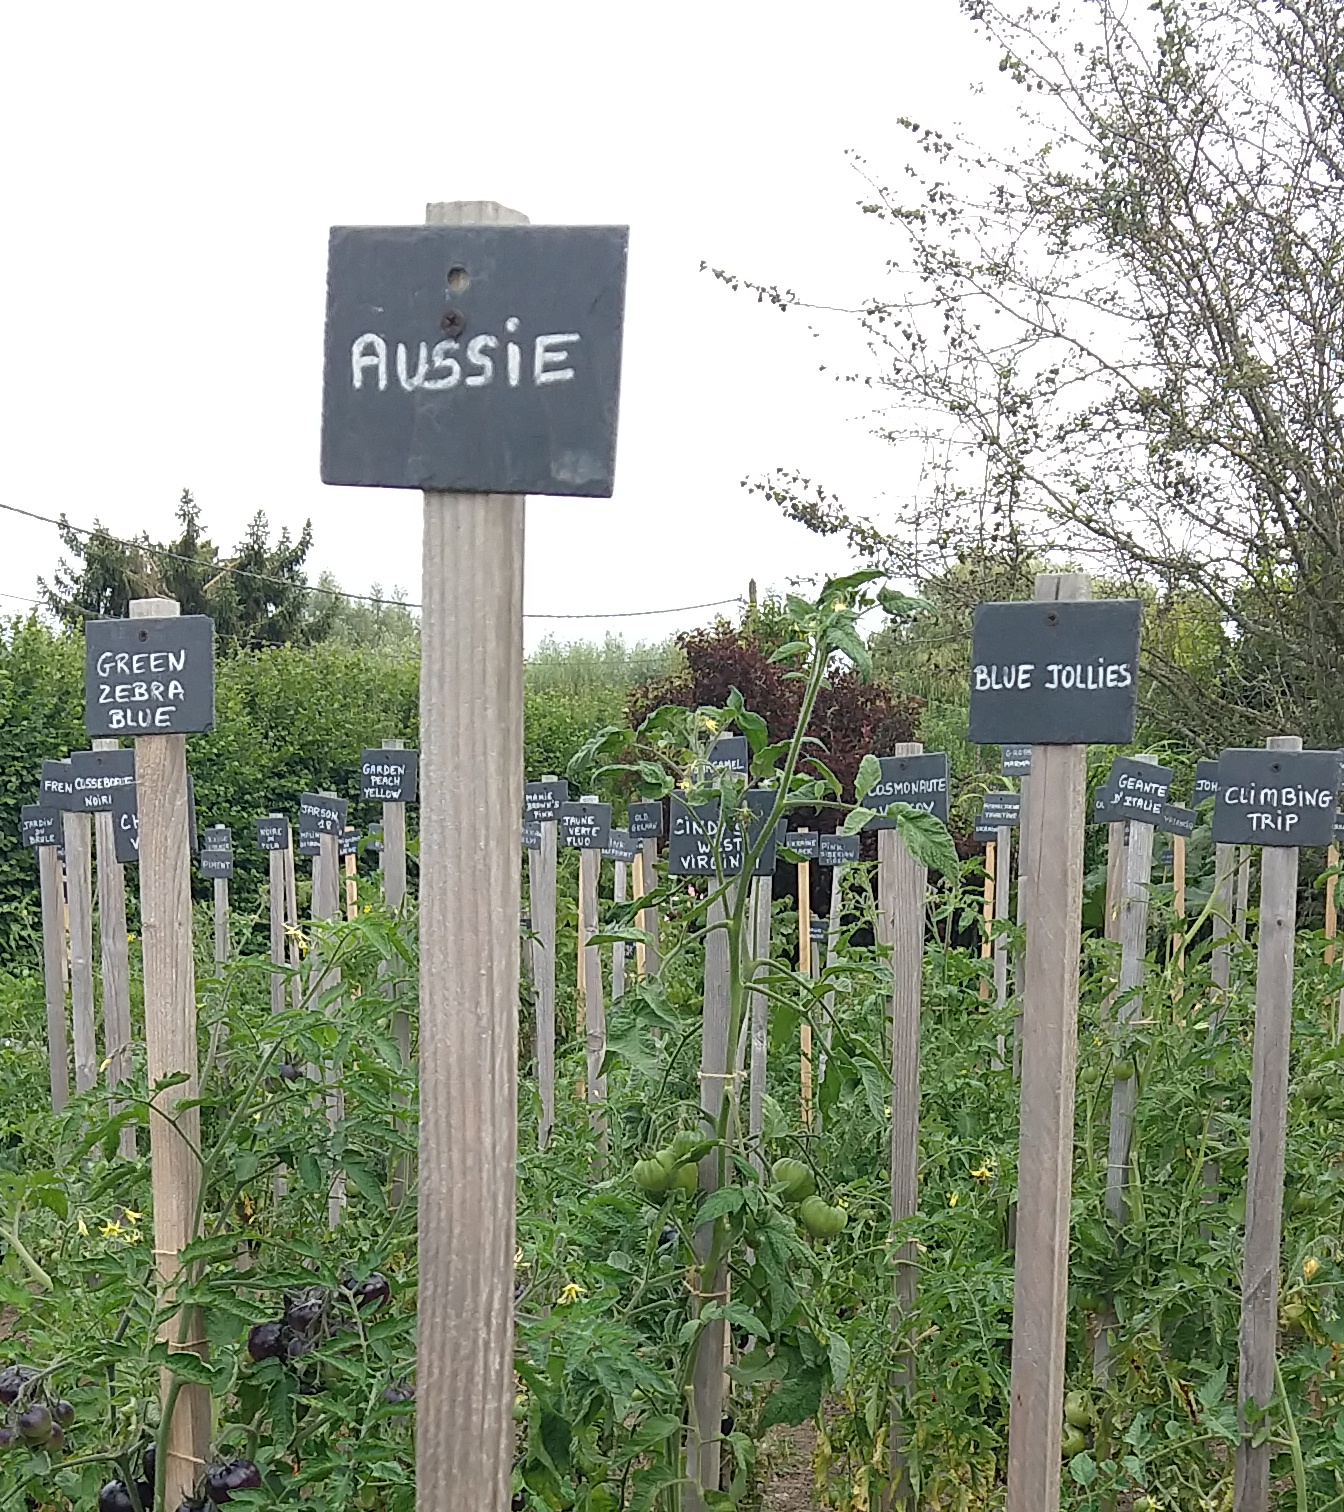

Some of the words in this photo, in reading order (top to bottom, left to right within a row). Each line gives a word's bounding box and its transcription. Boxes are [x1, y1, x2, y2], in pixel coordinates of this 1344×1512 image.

[96, 649, 186, 677] GREEN
[973, 663, 1035, 691] BLUE
[98, 680, 185, 704] ZEBRA
[108, 706, 177, 729] BLUE
[362, 763, 406, 776] GARDEN
[370, 775, 400, 787] PEACH
[363, 787, 402, 799] YELLOW
[1118, 774, 1168, 798] GEANTE
